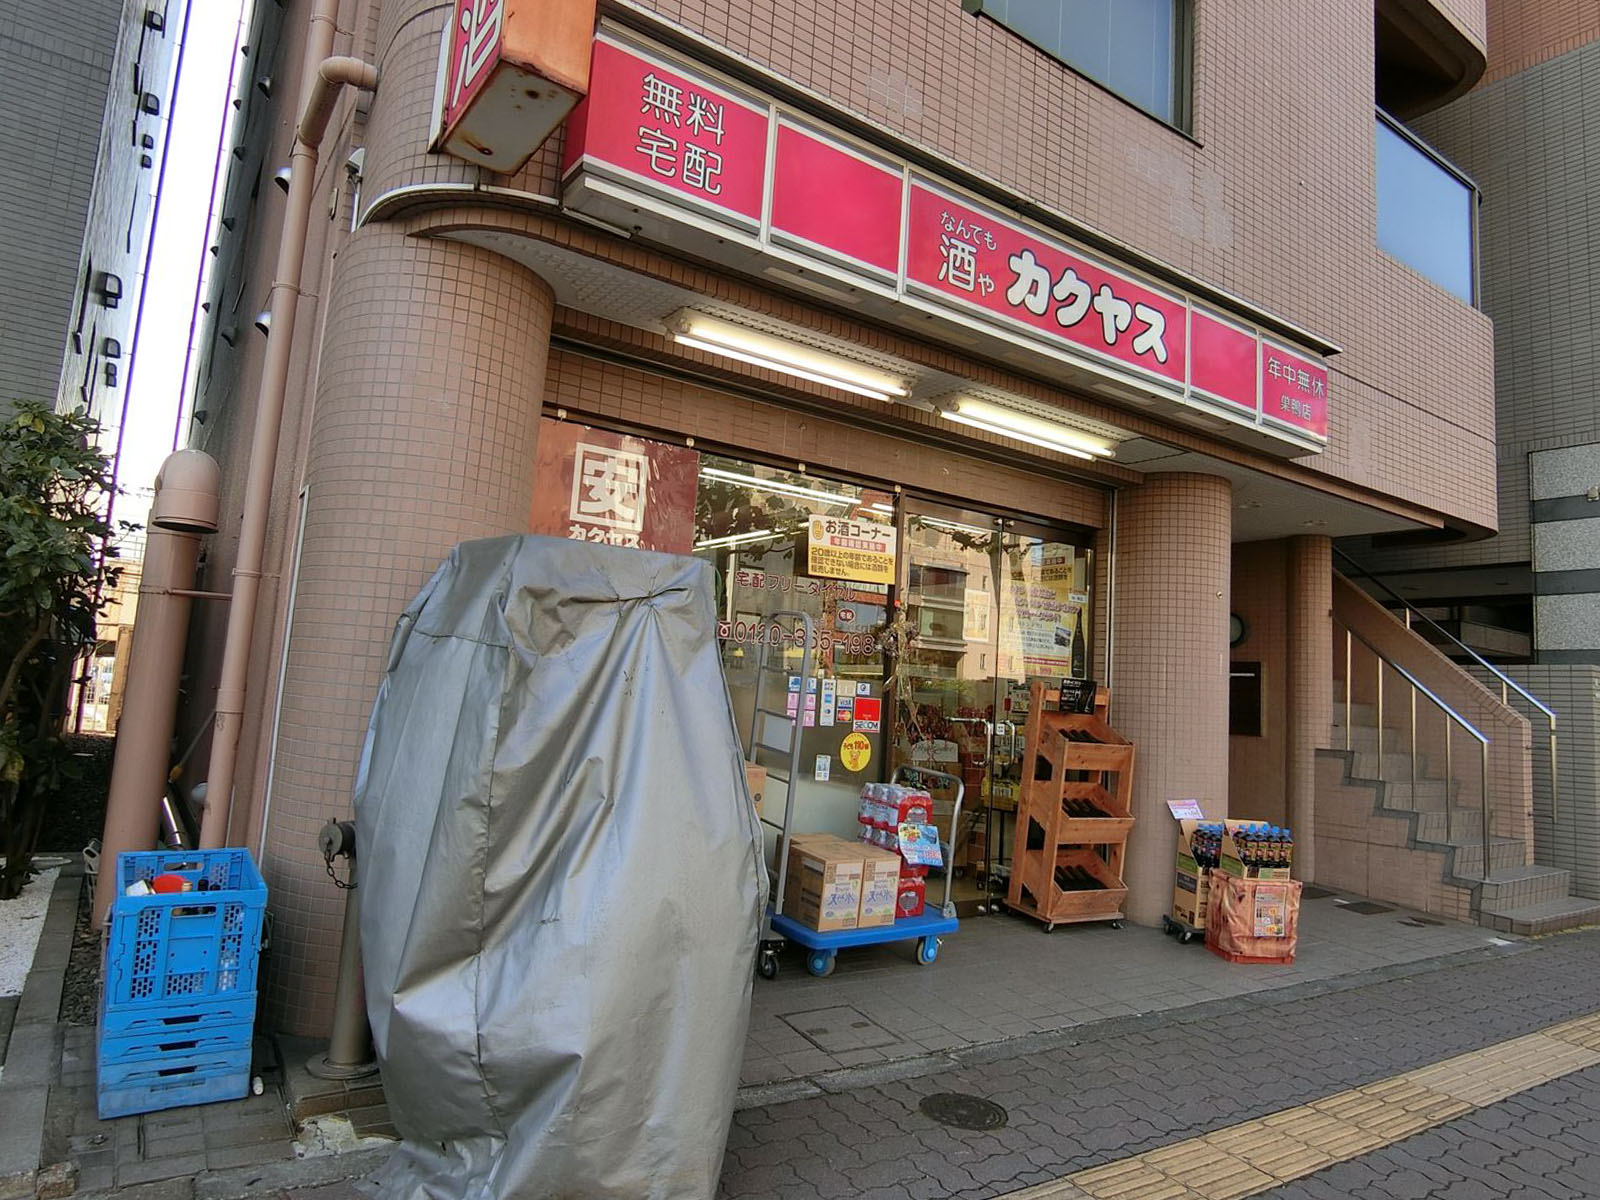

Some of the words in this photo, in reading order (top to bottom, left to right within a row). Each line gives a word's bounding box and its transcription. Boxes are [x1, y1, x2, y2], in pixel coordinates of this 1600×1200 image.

[640, 73, 726, 146] 無料
[635, 126, 723, 195] 宅配
[940, 209, 998, 251] なんでも
[937, 233, 996, 298] 酒や
[1006, 248, 1169, 364] カクヤス
[1267, 356, 1325, 399] 年中無休
[1280, 394, 1312, 422] 巣鴨店
[567, 524, 641, 549] カクヤス
[824, 519, 892, 540] お酒コーナー
[854, 720, 879, 730] SECOM
